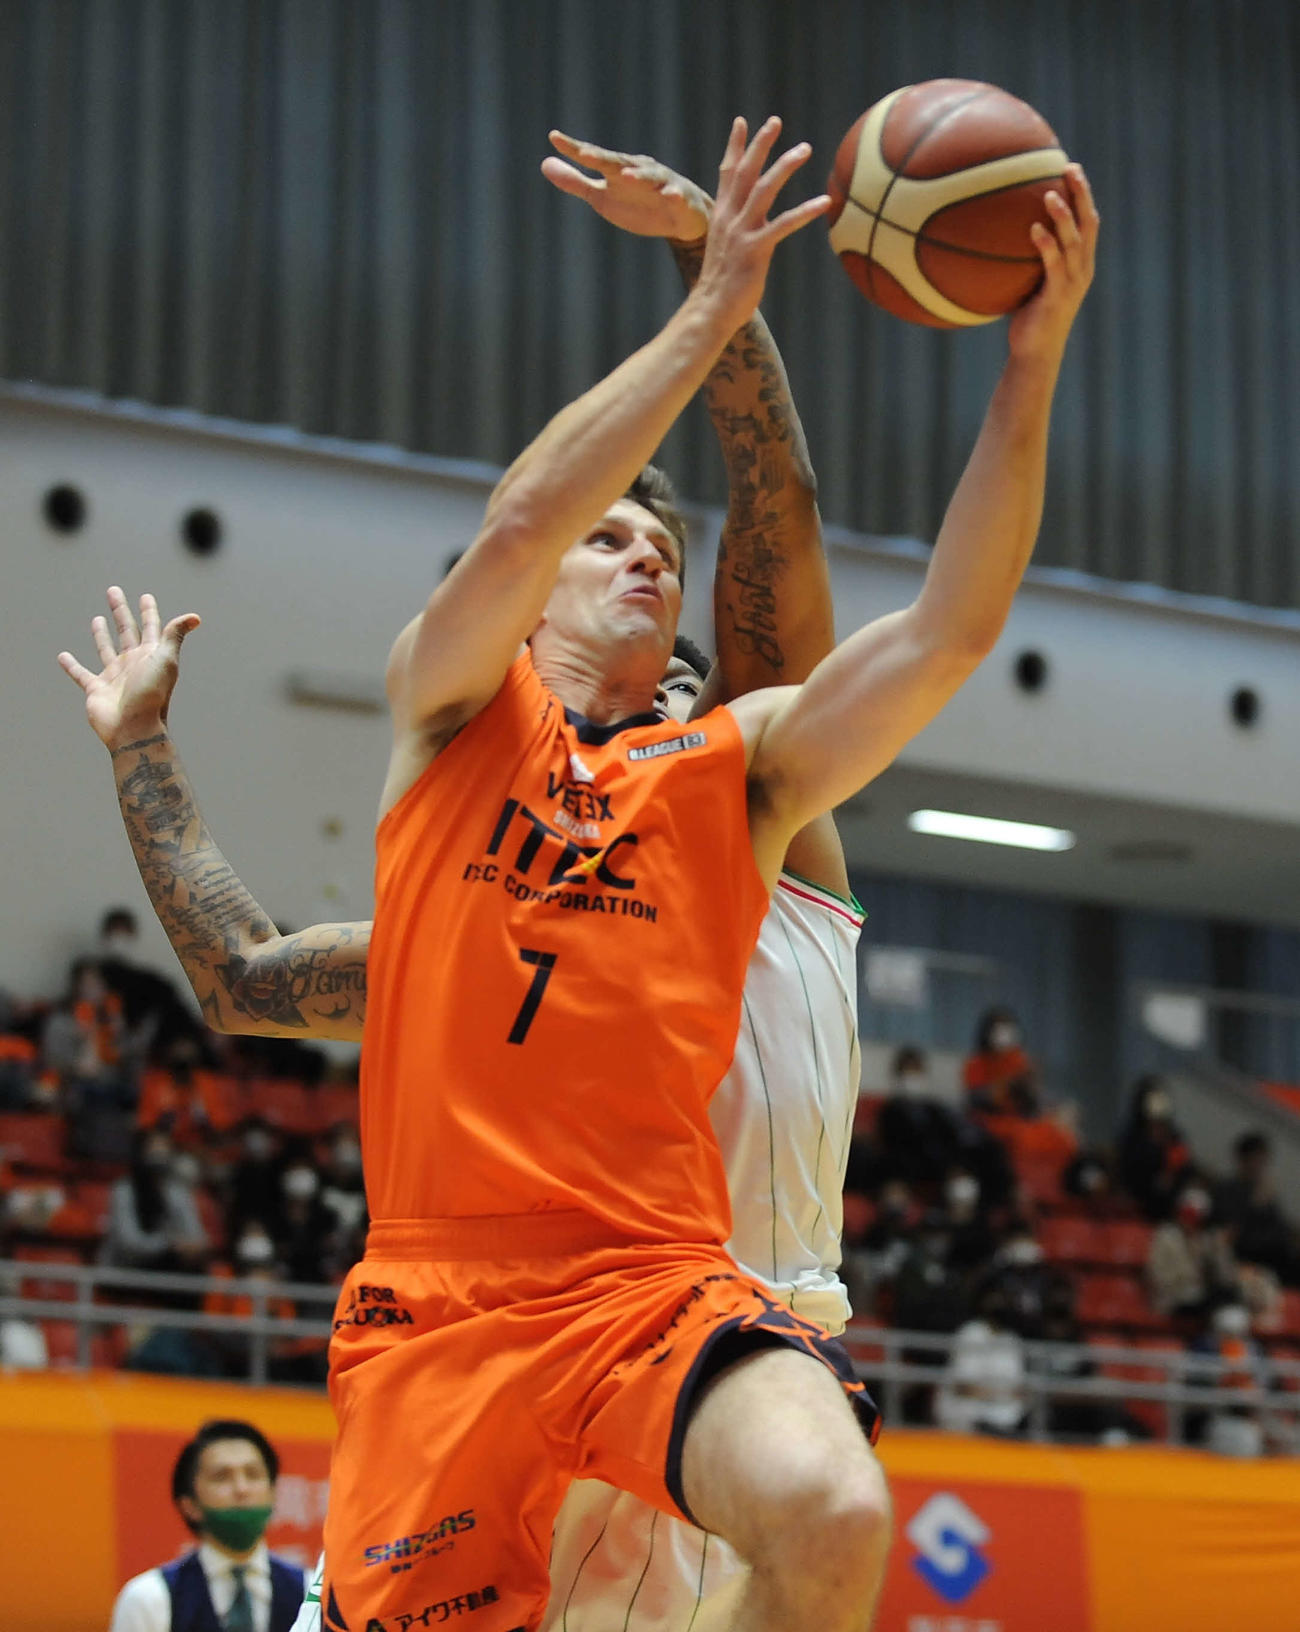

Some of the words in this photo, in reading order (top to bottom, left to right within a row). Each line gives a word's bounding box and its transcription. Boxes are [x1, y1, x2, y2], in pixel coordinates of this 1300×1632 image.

[486, 798, 638, 889] ITEC
[504, 874, 658, 923] CORPORATION
[507, 947, 557, 1045] 7
[359, 1286, 397, 1304] FOR
